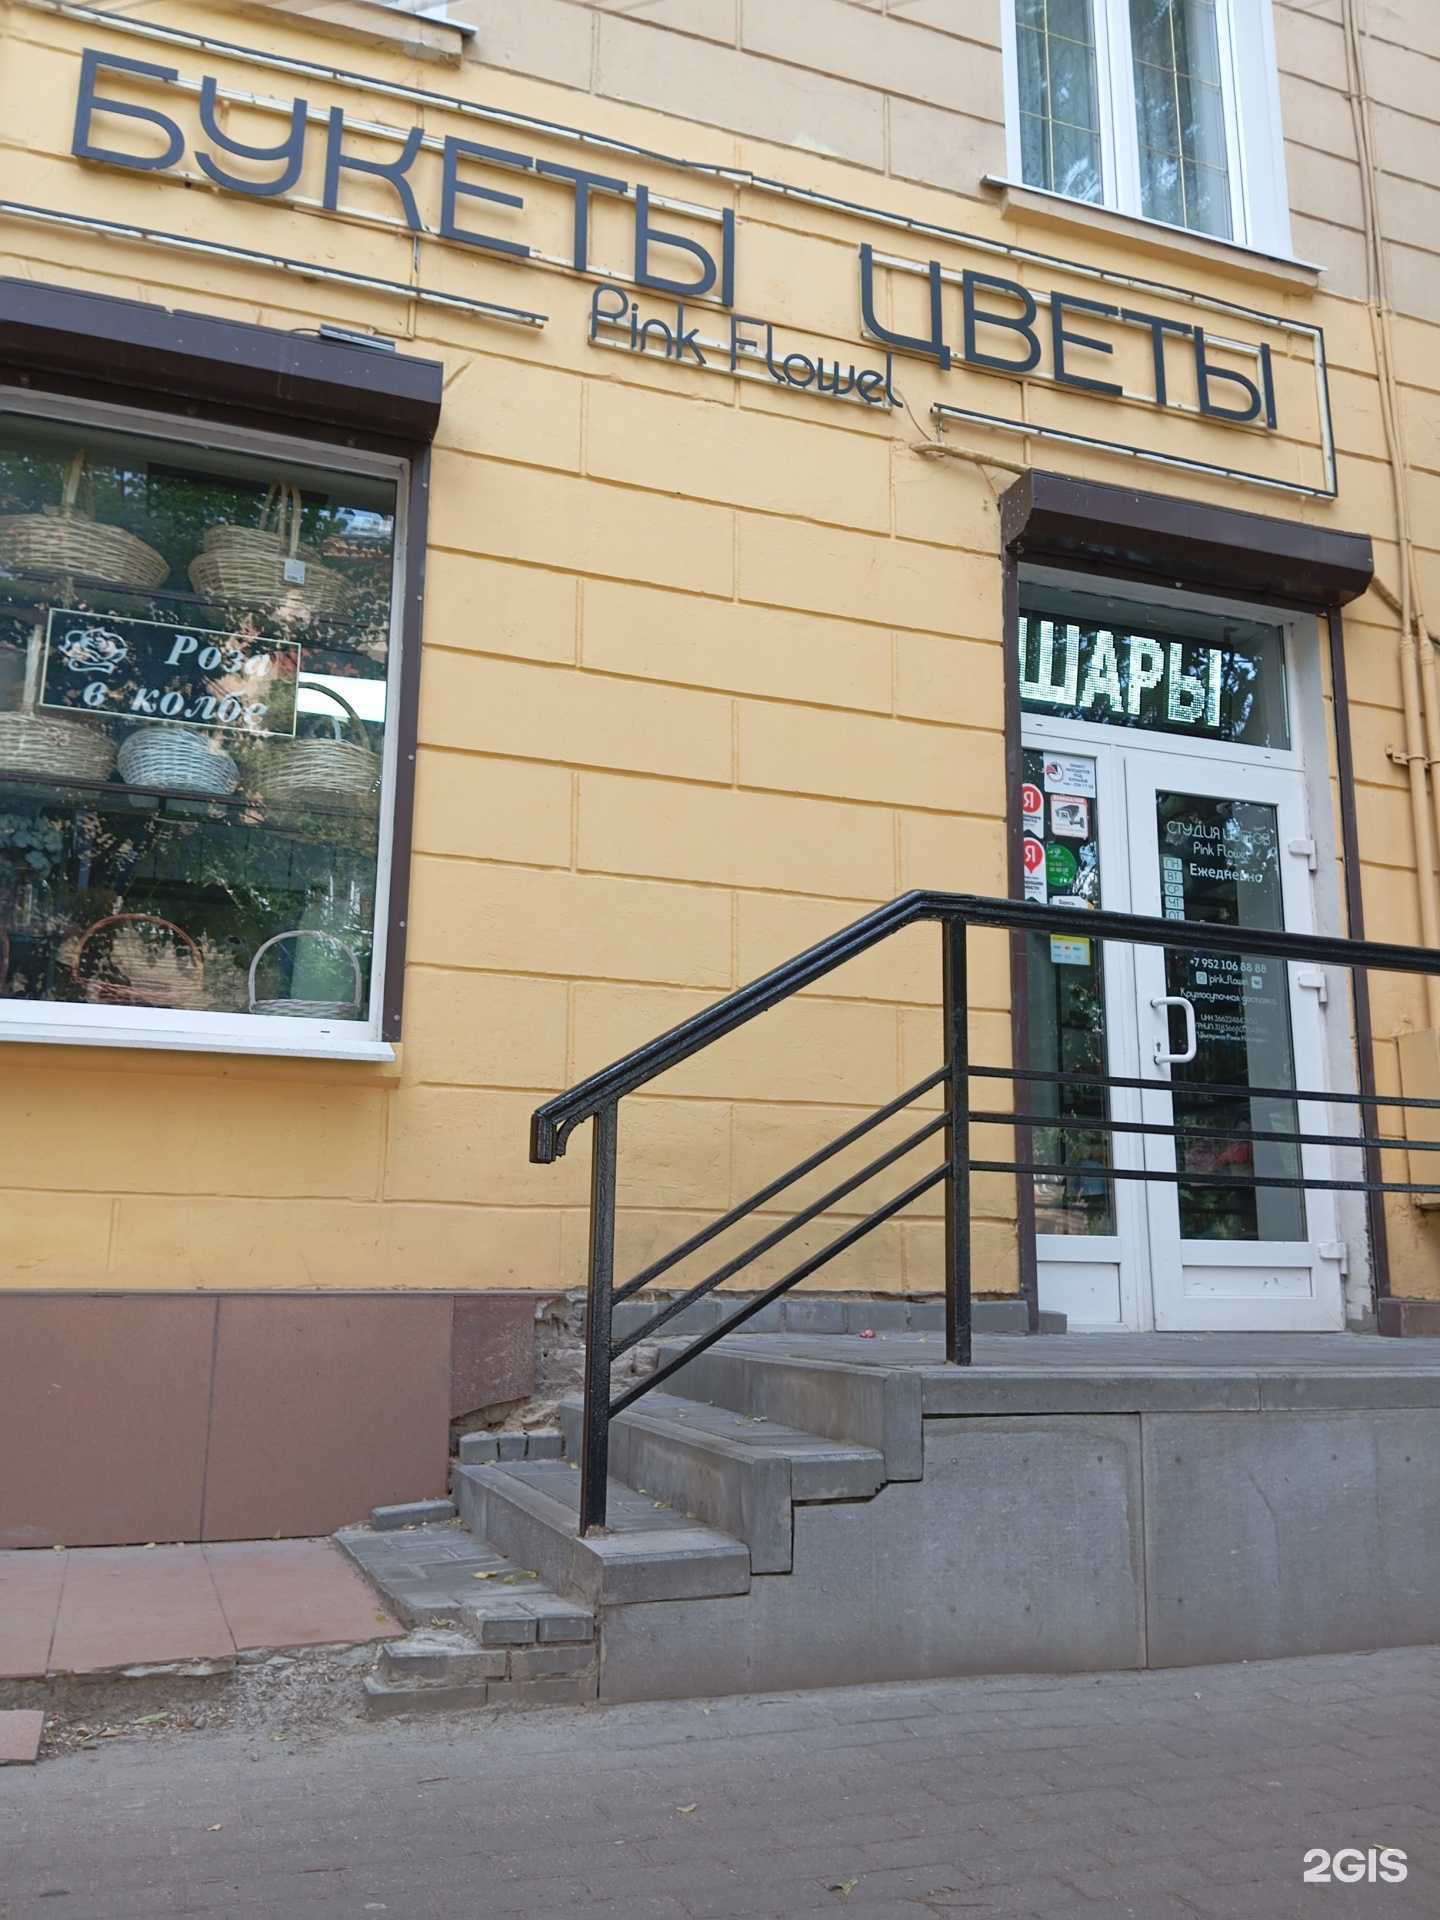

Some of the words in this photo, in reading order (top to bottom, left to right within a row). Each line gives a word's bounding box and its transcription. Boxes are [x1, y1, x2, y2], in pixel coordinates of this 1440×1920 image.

[71, 48, 736, 308] БУКЕТЫ
[861, 243, 1276, 430] ЦВЕТЫ
[592, 284, 708, 365] Pink
[164, 634, 270, 677] Роза
[1018, 616, 1222, 727] ШАРЫ
[83, 682, 108, 706] в
[131, 687, 268, 725] колбе
[1193, 841, 1215, 857] Pink
[1190, 862, 1263, 883] Ежедневно
[1201, 958, 1220, 970] 952
[1221, 960, 1239, 971] 106
